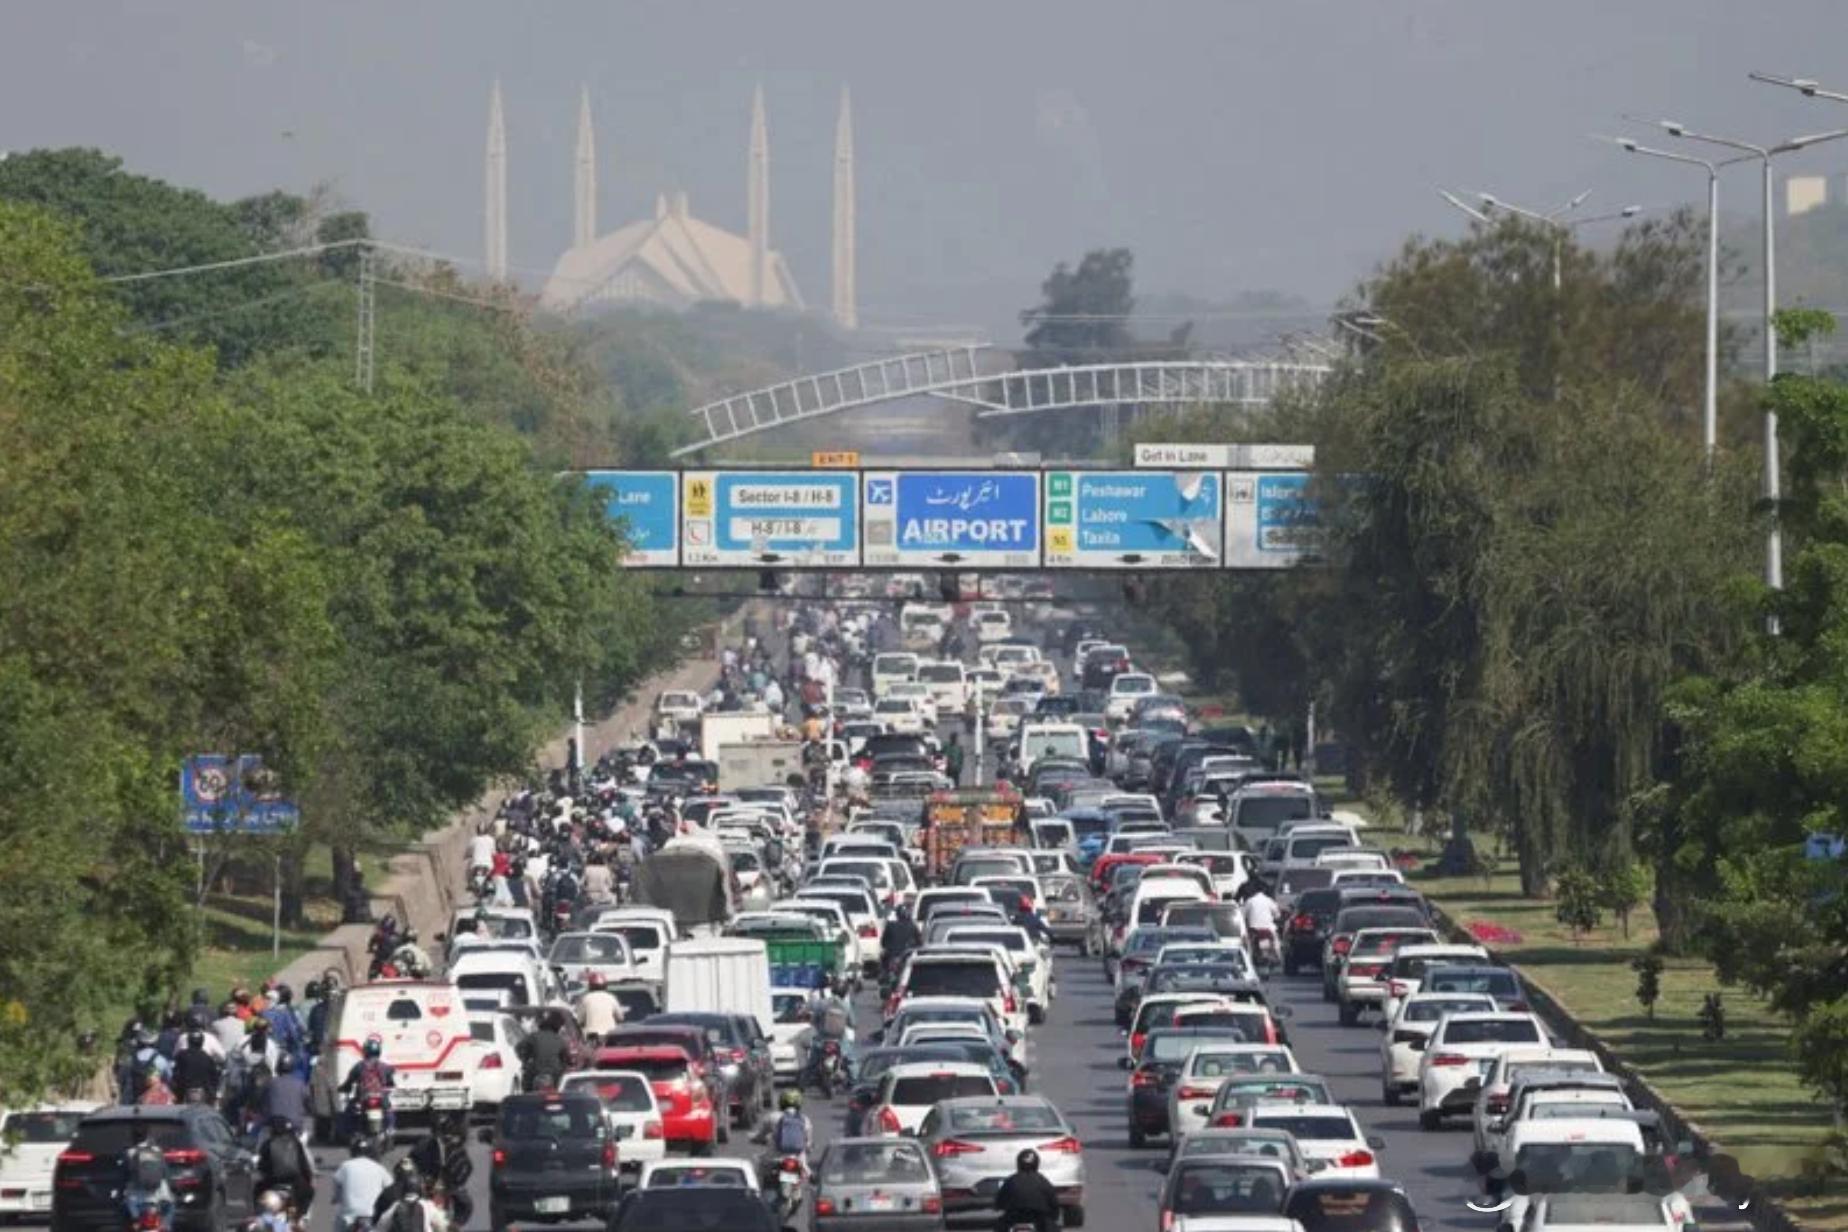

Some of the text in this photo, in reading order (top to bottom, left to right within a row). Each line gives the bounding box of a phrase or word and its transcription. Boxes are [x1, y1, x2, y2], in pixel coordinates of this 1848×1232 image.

[1141, 449, 1208, 462] Get in Lane
[618, 490, 651, 505] Lane
[739, 489, 779, 504] Sector
[1081, 482, 1147, 498] Peshawar
[1081, 507, 1128, 523] Lahore
[902, 518, 1028, 545] AIRPORT
[1082, 530, 1121, 545] Taxila
